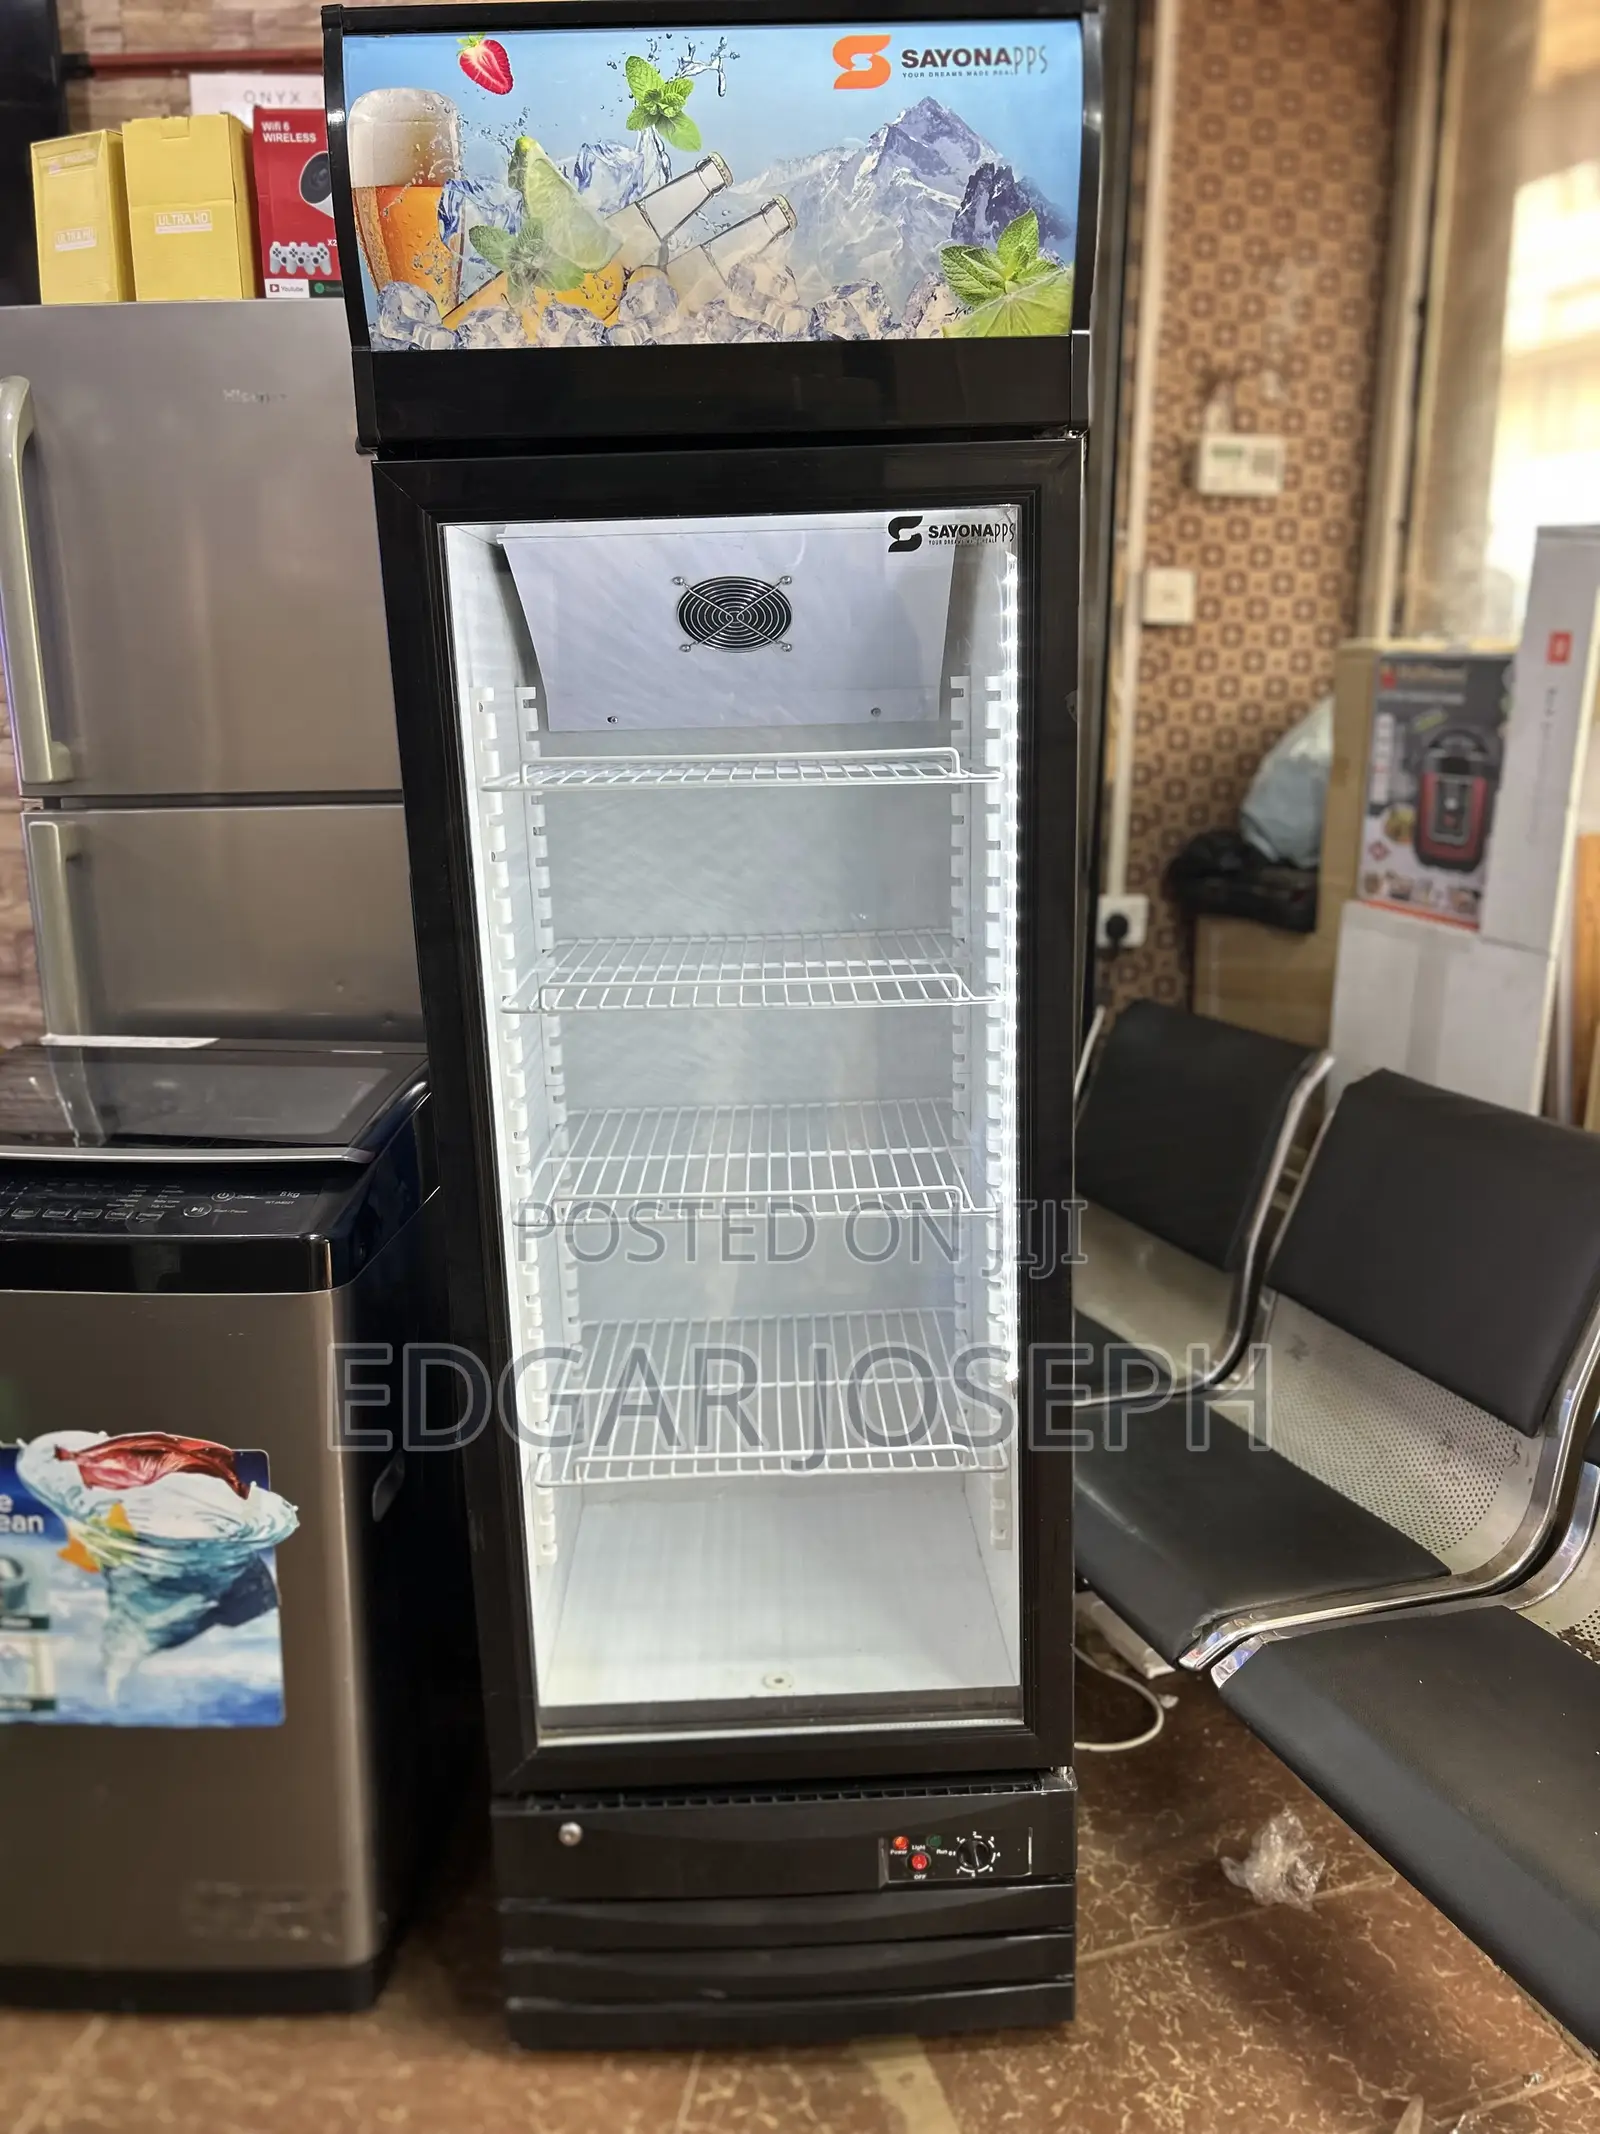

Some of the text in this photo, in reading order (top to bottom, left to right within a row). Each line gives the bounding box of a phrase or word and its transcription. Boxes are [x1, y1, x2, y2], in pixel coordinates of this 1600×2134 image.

[243, 89, 303, 104] ONYX
[283, 121, 290, 131] 6
[263, 133, 317, 143] WIRELESS
[158, 212, 208, 226] ULTRA HD
